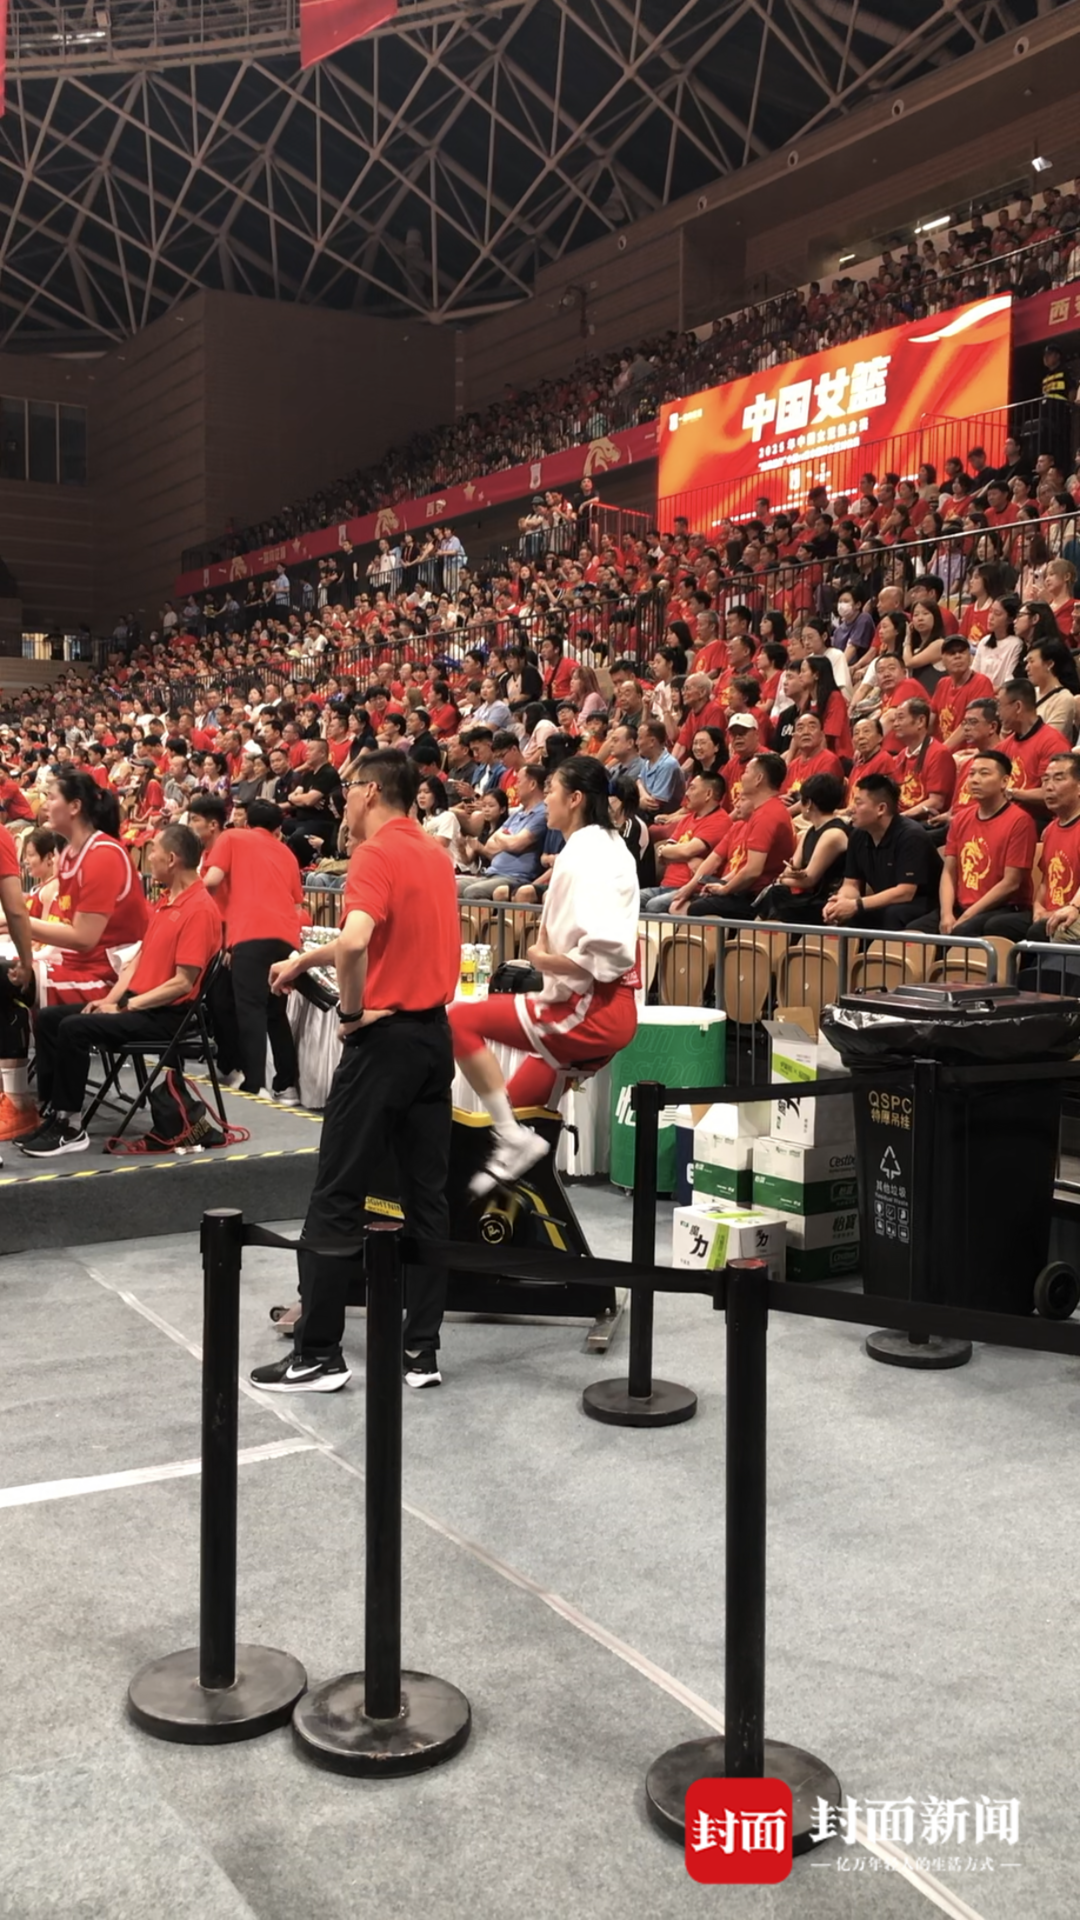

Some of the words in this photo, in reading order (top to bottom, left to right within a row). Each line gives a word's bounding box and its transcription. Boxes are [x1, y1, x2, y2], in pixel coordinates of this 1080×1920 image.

[742, 355, 892, 443] 中国女篮
[868, 1090, 912, 1115] QSPC
[876, 1179, 907, 1199] 其他垃圾
